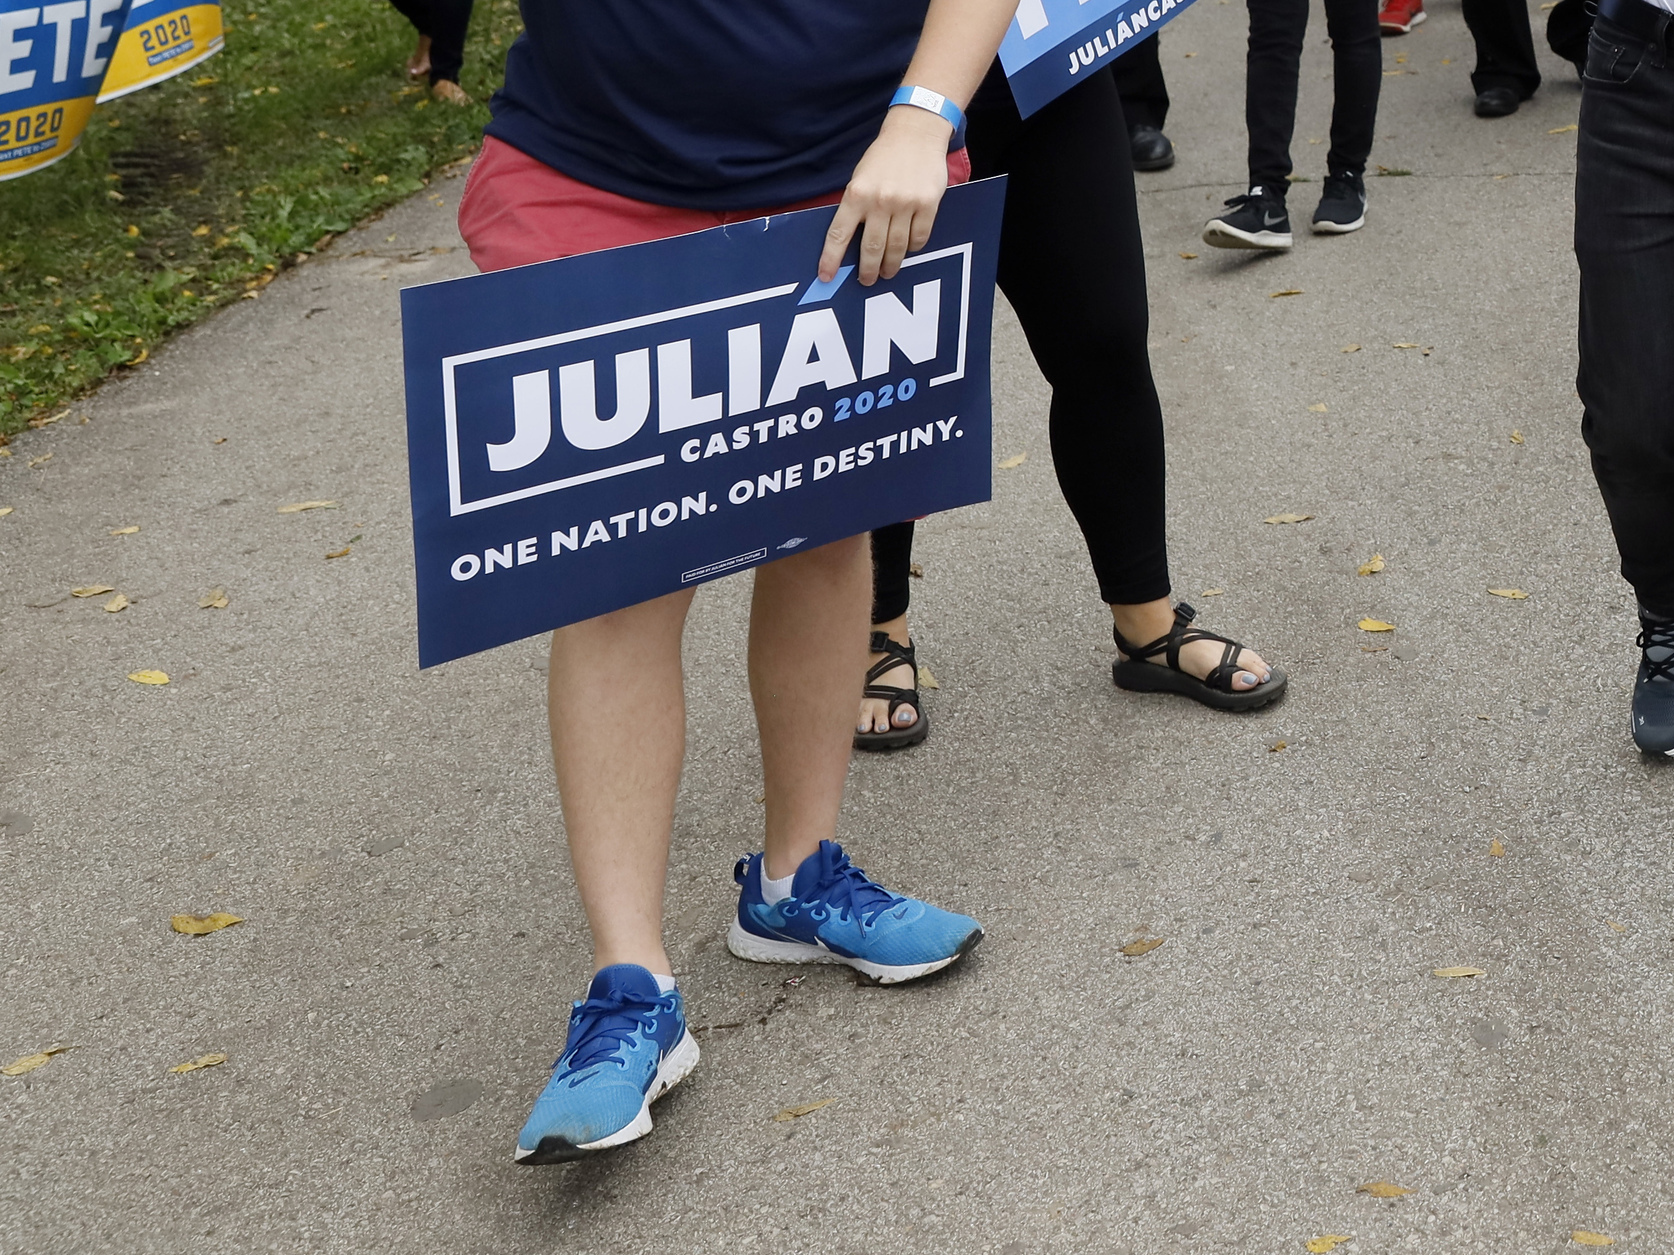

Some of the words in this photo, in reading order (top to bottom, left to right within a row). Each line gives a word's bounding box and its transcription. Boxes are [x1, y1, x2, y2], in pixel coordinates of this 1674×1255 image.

[140, 14, 191, 52] 2020
[0, 107, 64, 144] 2020
[486, 265, 942, 472] JULIÁN
[680, 407, 824, 463] CASTRO
[833, 378, 917, 422] 2020
[450, 536, 539, 581] ONE
[551, 491, 718, 557] NATION.
[728, 463, 803, 506] ONE
[812, 415, 964, 482] DESTINY.
